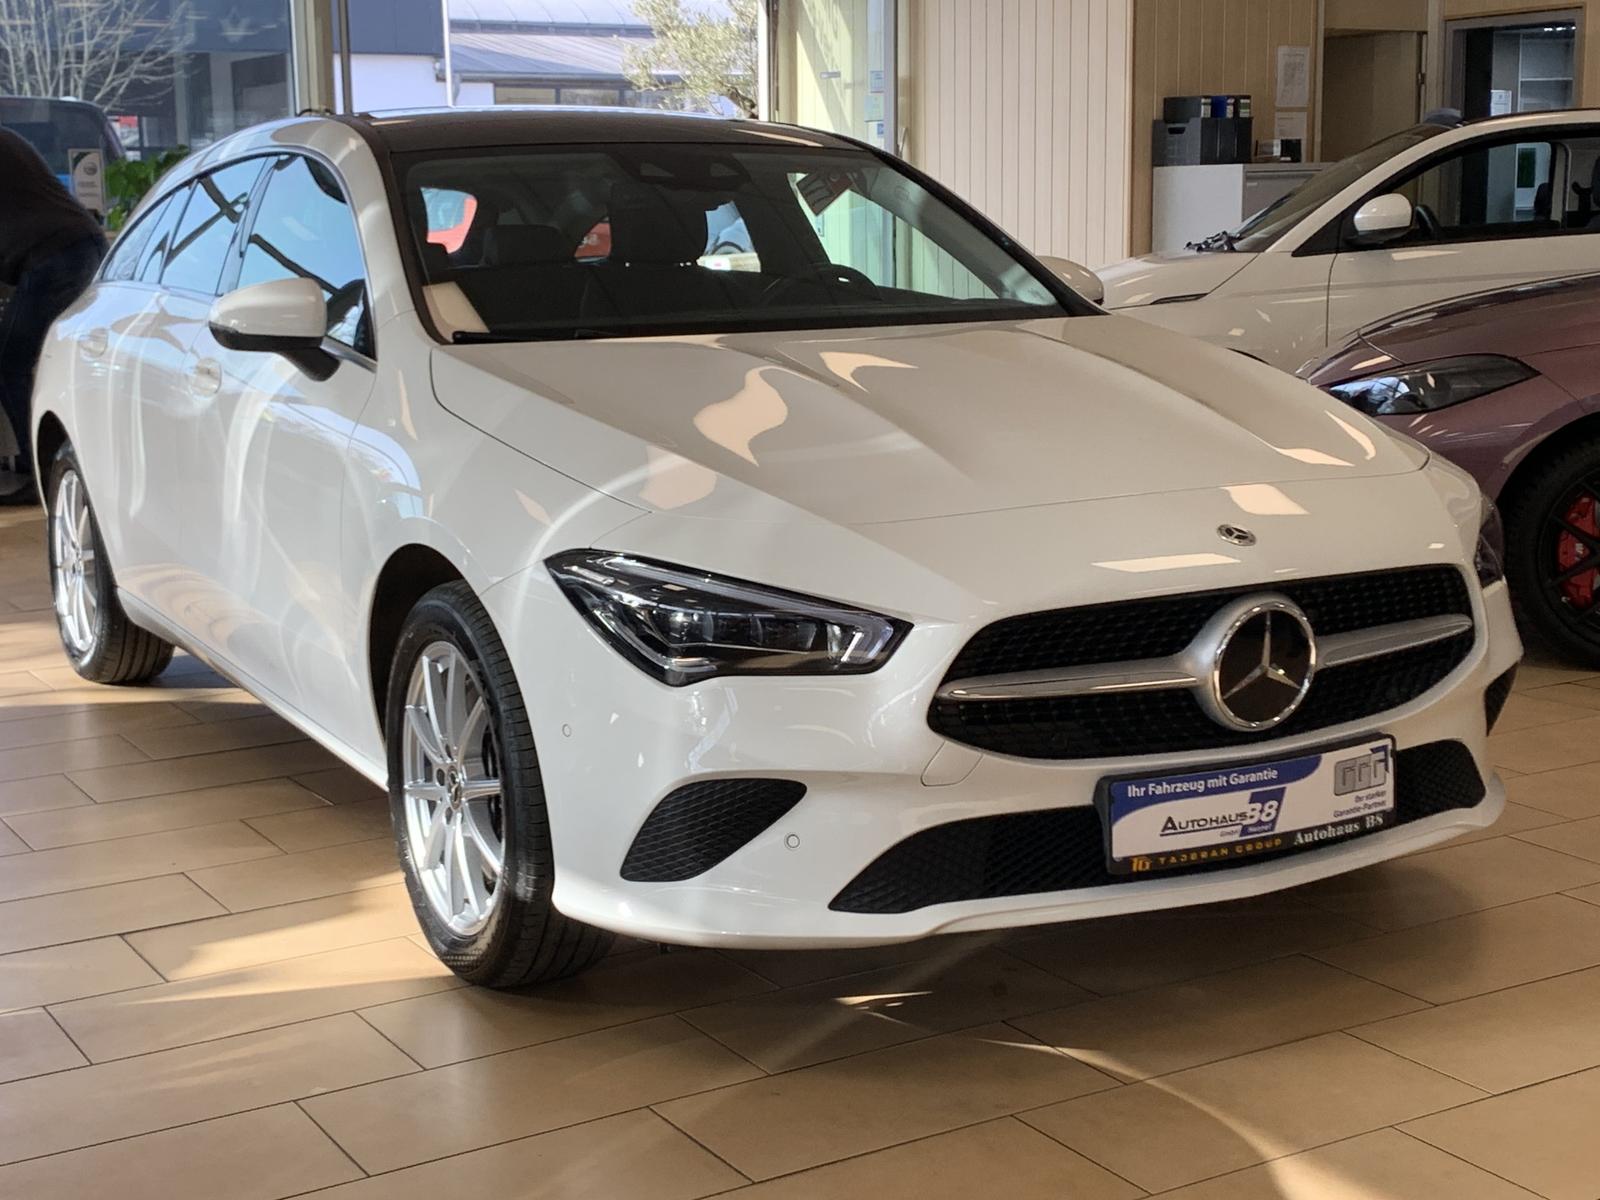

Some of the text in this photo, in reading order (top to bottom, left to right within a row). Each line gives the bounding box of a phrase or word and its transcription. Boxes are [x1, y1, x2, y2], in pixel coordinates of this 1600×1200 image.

[1127, 767, 1279, 797] Ihr Fahrzeug mit Garantie
[1293, 822, 1361, 846] Autohaus
